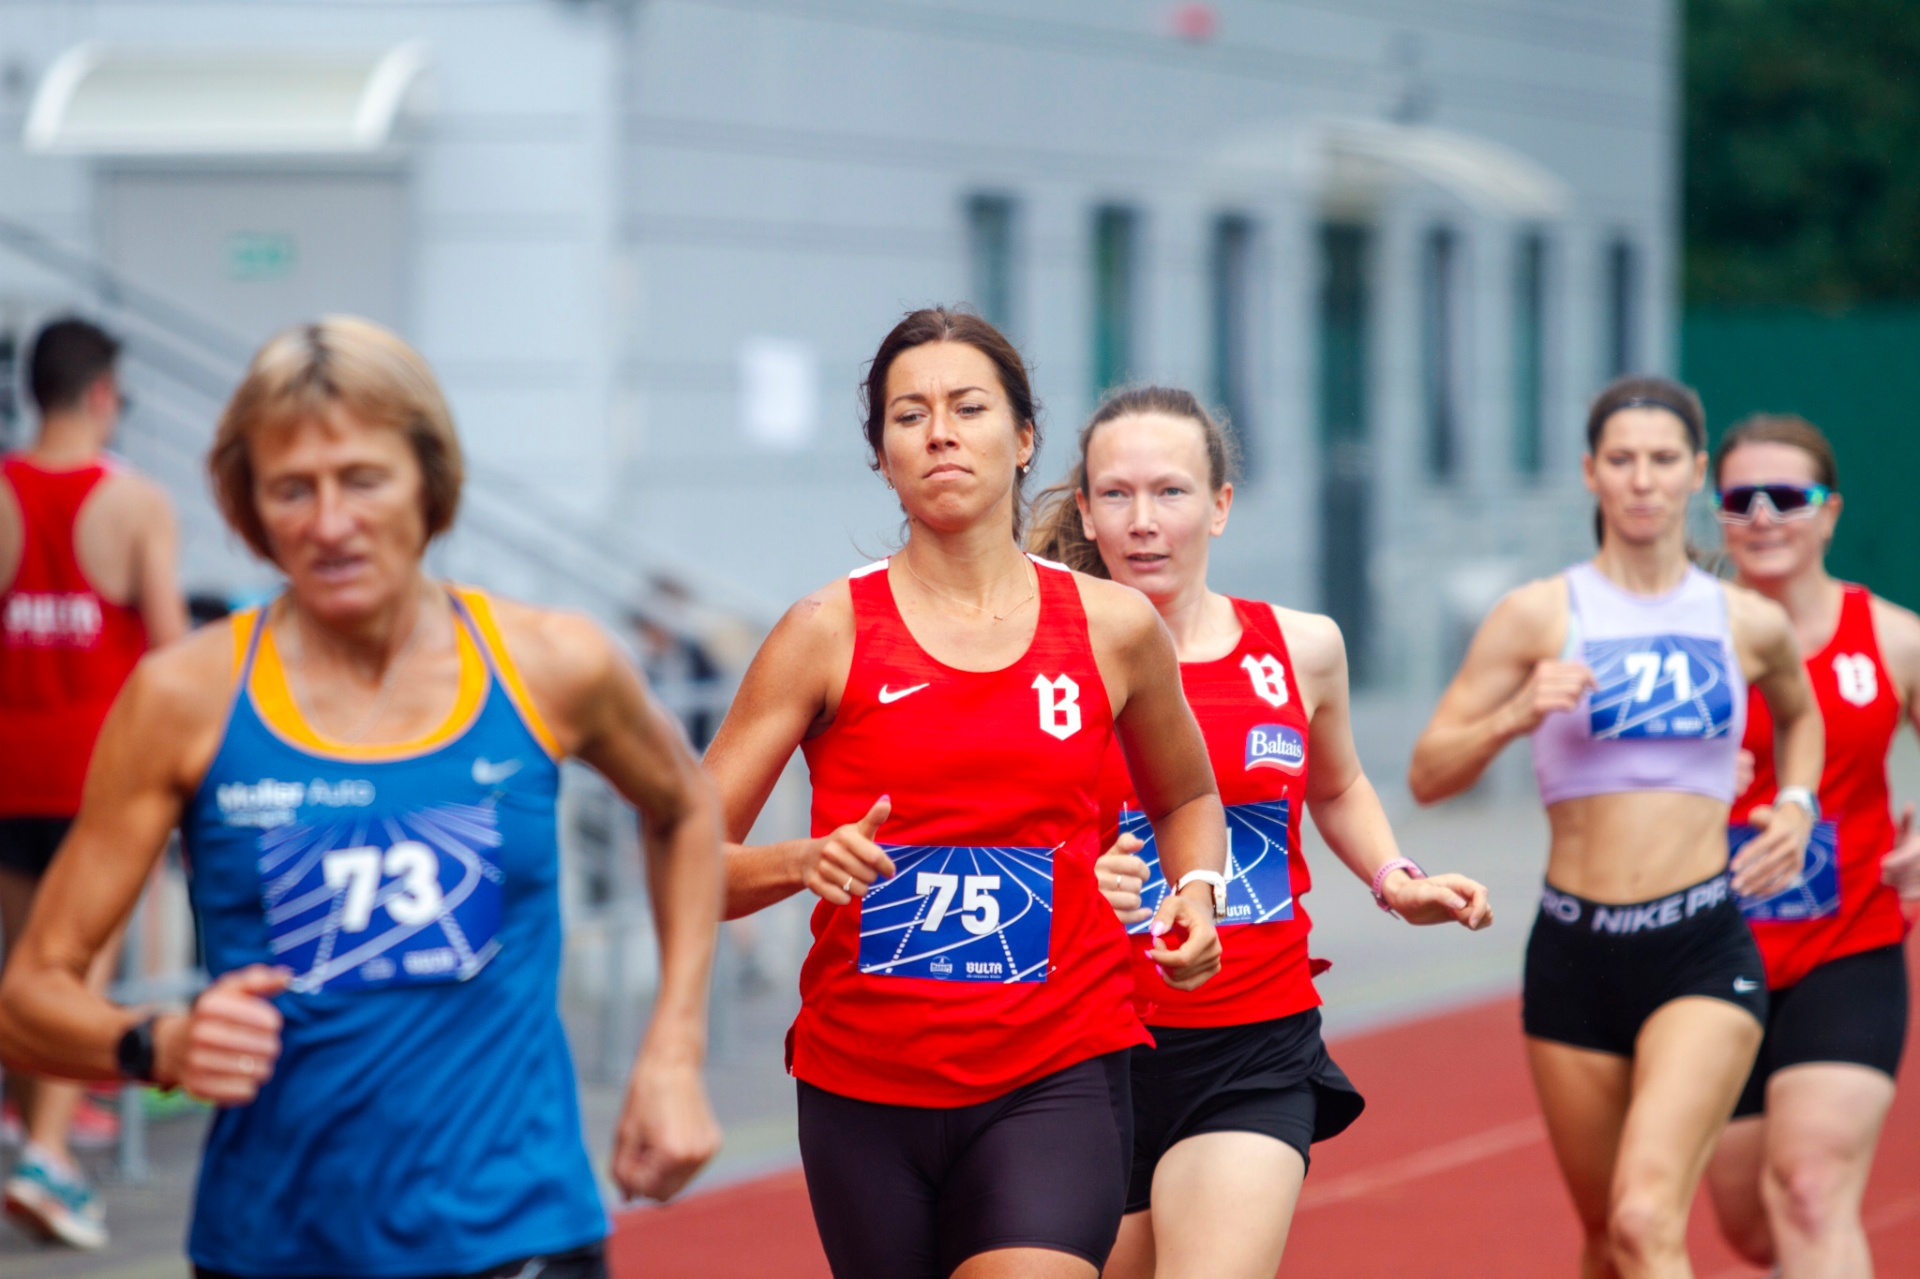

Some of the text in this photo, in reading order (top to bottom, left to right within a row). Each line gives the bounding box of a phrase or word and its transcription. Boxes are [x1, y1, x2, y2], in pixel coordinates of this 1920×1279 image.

[1625, 651, 1690, 702] 71
[1251, 730, 1302, 759] Baltais
[322, 840, 443, 933] 73
[915, 872, 1001, 936] 75
[1227, 904, 1251, 918] ULTA
[1591, 892, 1684, 934] NIKE
[966, 961, 1003, 975] BULTA
